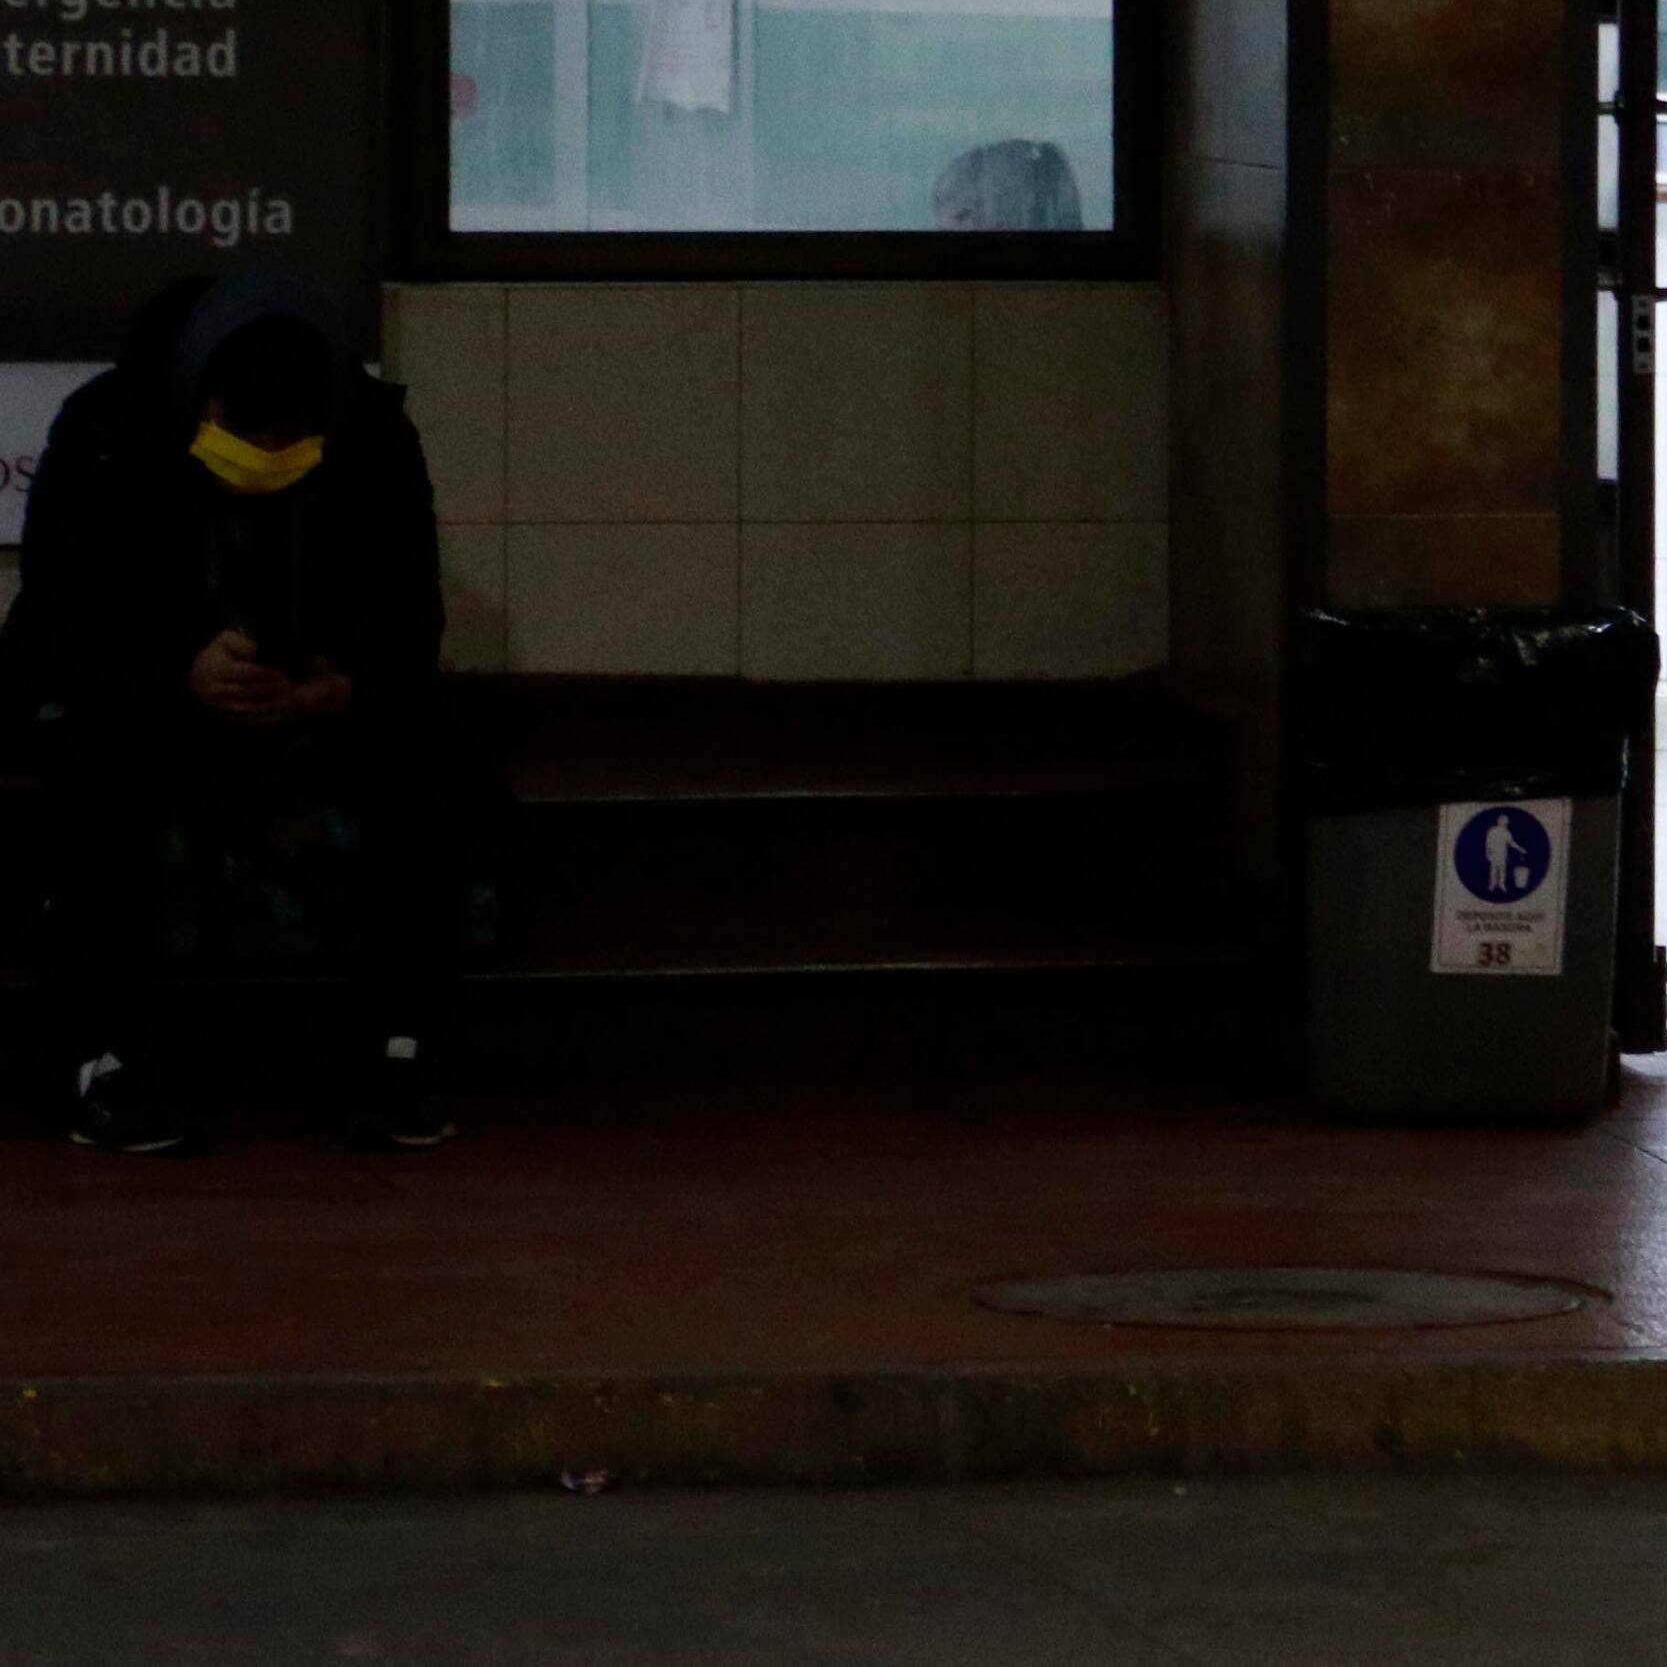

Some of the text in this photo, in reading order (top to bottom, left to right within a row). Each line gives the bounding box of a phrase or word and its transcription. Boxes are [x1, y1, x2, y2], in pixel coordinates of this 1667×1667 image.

[2, 28, 238, 77] ternidad
[0, 185, 293, 247] onatología
[1480, 942, 1511, 966] 38
